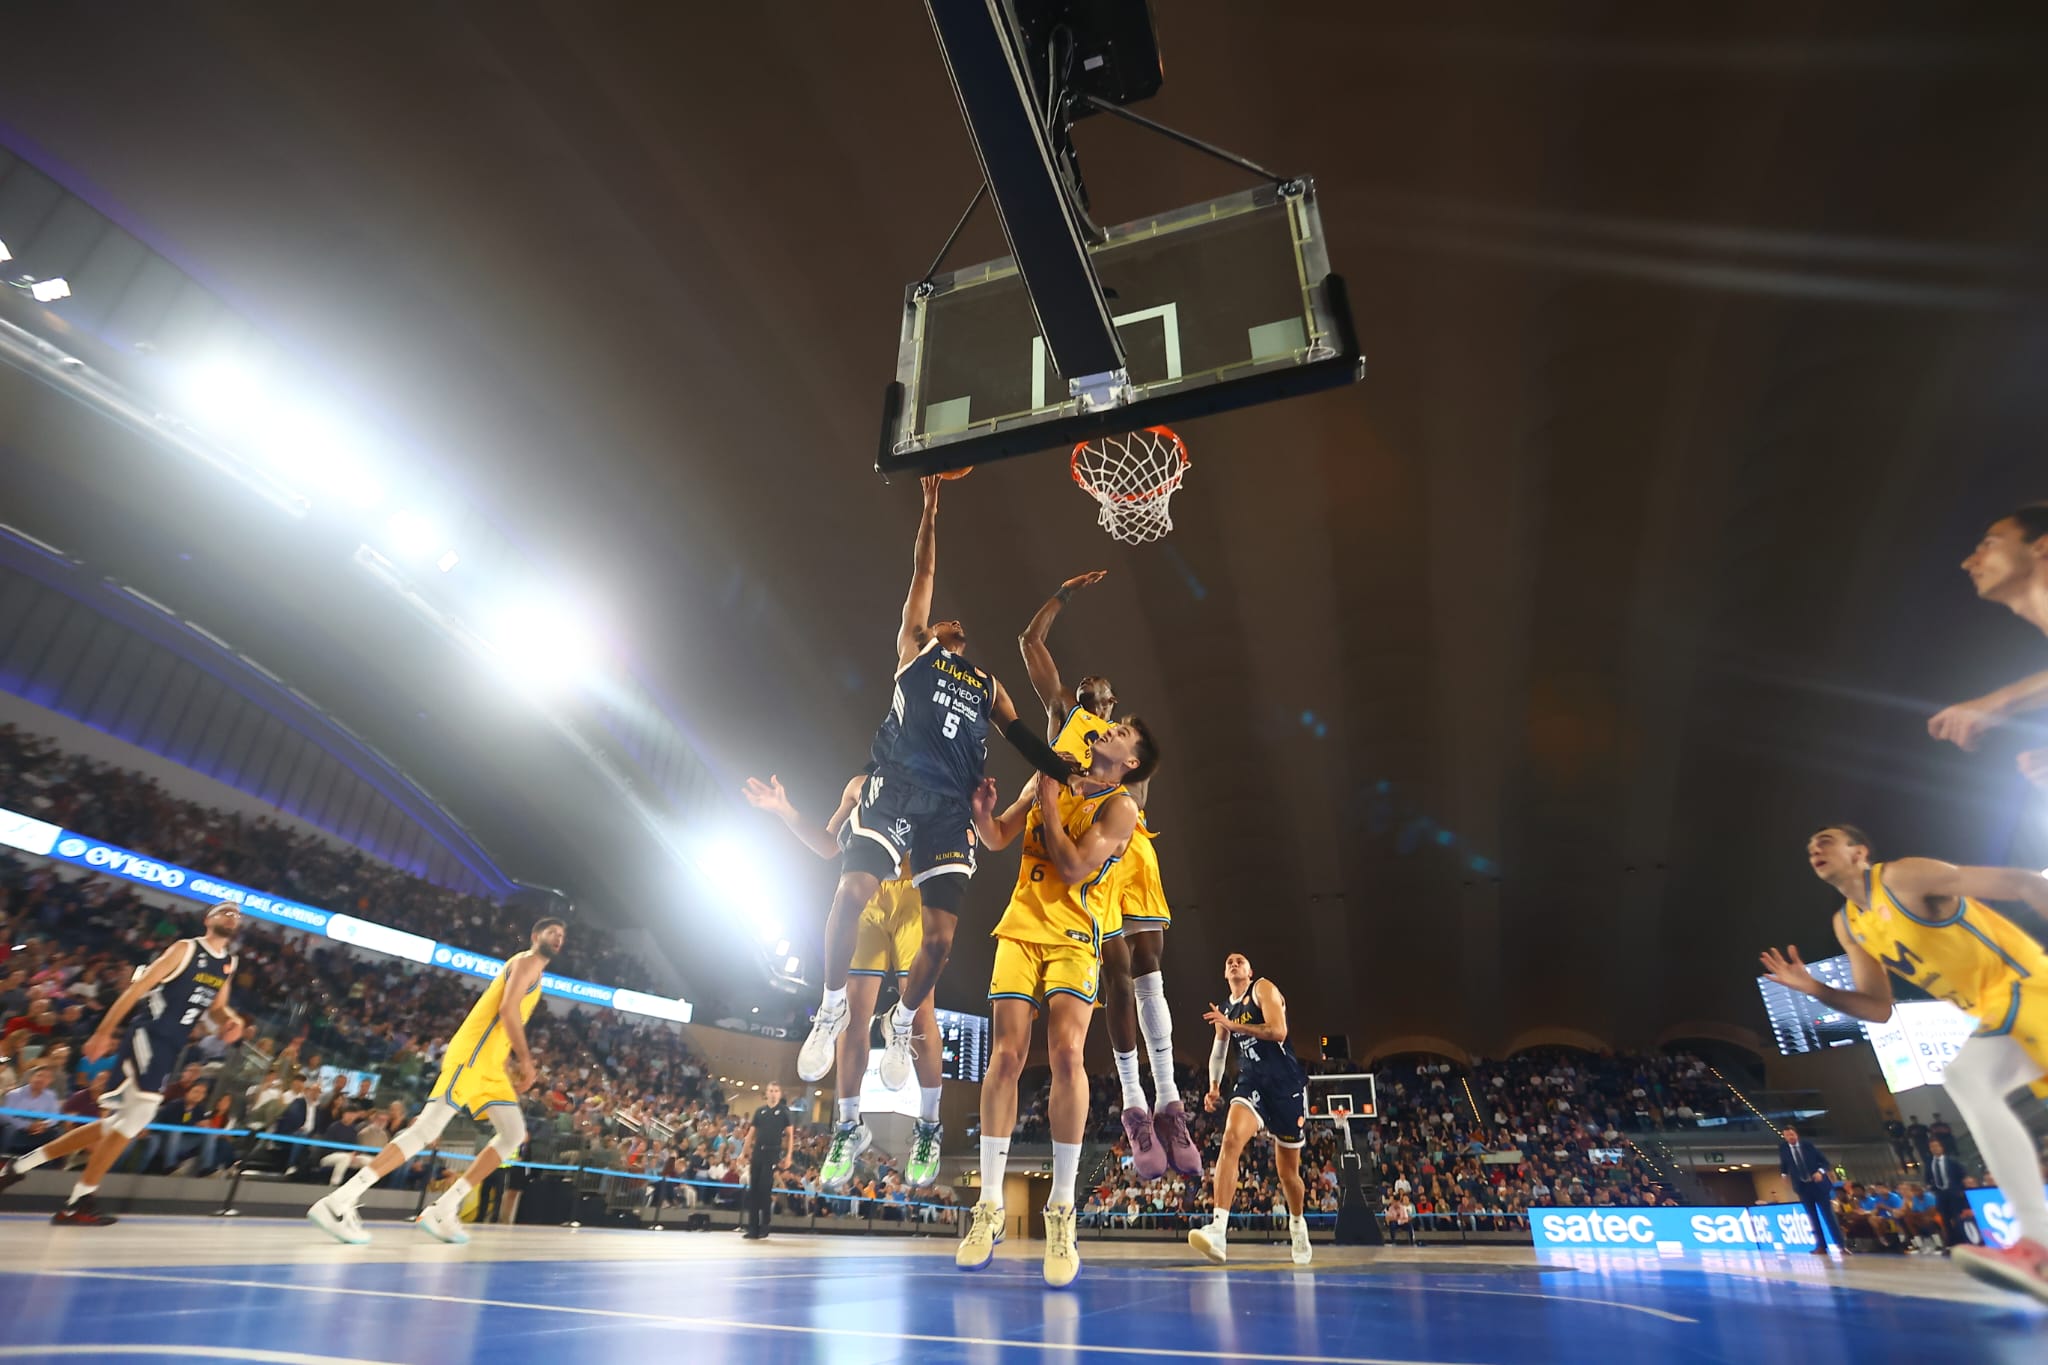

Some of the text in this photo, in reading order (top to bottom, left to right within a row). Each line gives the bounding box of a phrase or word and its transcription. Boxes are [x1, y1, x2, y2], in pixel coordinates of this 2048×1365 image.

[947, 682, 981, 705] OVIEDO
[942, 711, 961, 739] 5
[85, 846, 187, 888] OVIEDO
[1030, 863, 1047, 883] 6
[180, 1007, 201, 1025] 2
[1542, 1209, 1655, 1243] satec
[1776, 1206, 1818, 1245] sate
